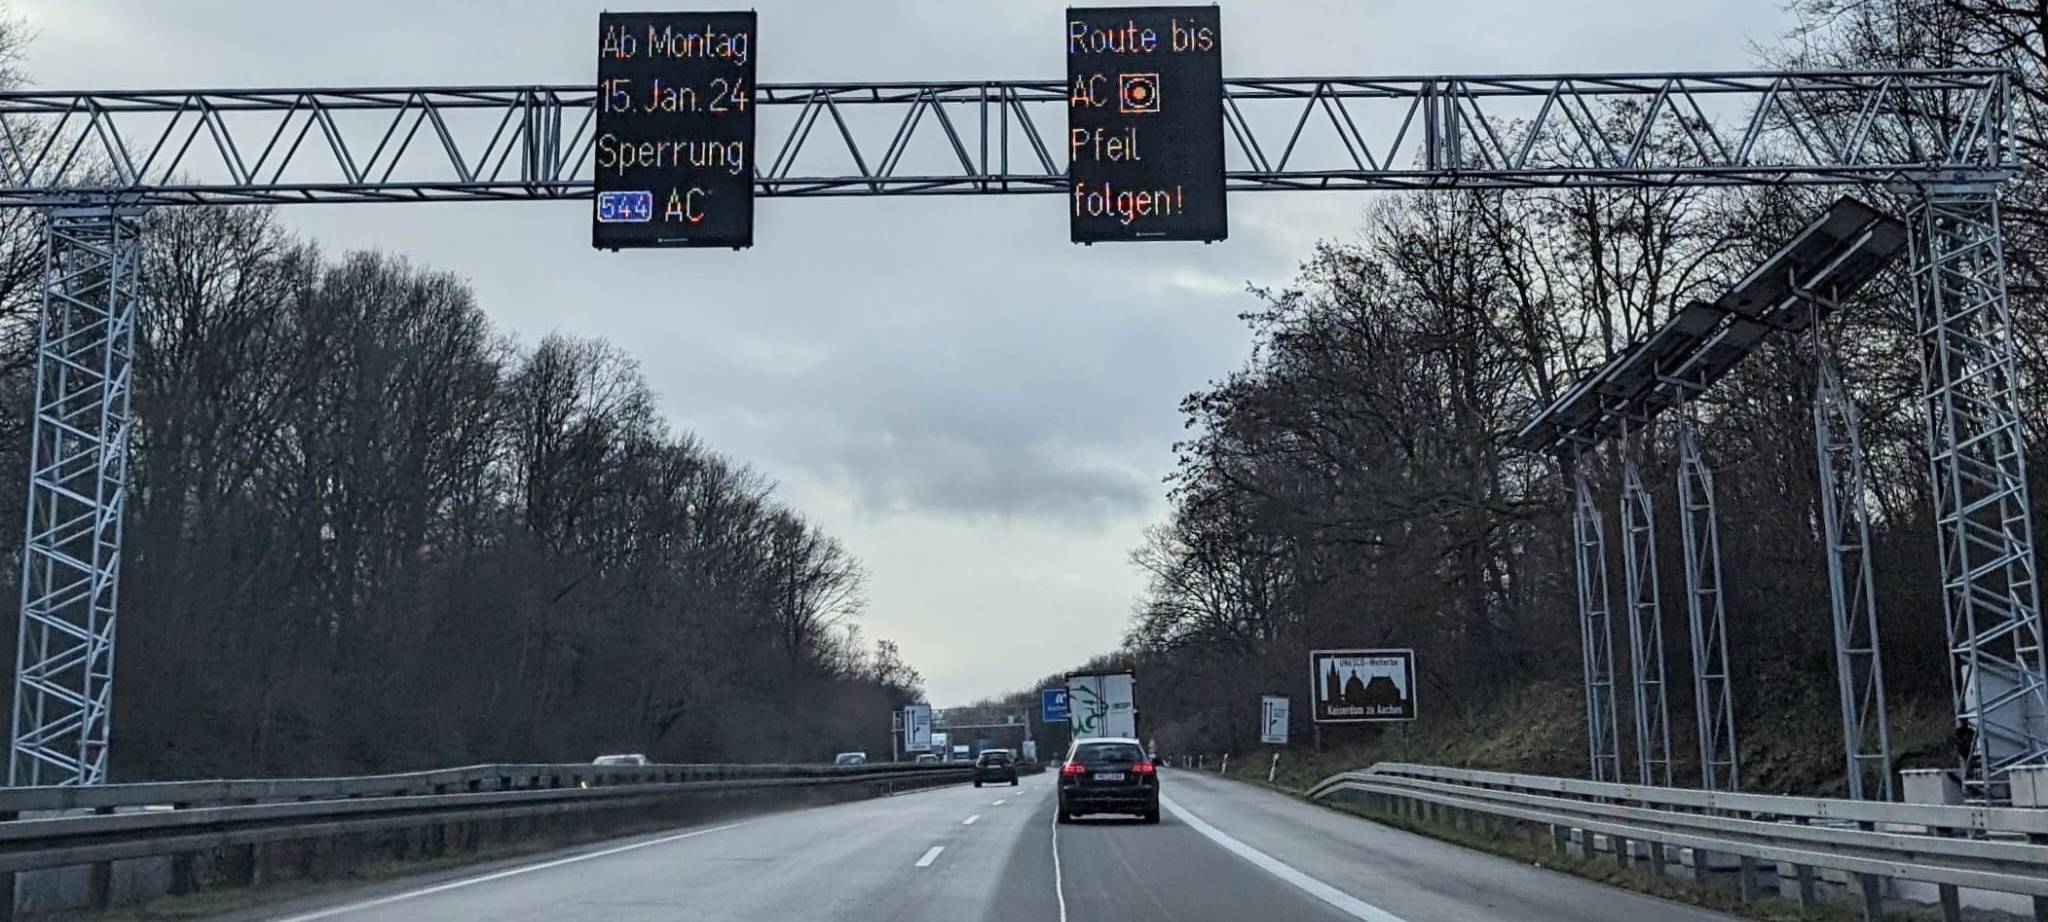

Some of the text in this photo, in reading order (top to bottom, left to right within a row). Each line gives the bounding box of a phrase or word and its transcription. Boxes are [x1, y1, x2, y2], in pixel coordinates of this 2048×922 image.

[602, 24, 748, 66] Ab Montag
[1070, 18, 1213, 53] Route bis
[601, 77, 748, 113] 15. Jan. 24
[1072, 74, 1107, 107] AC
[598, 133, 743, 176] Sperrung
[1072, 127, 1141, 162] Pfeil
[602, 187, 704, 222] 544 AC
[1075, 182, 1183, 225] folgen!
